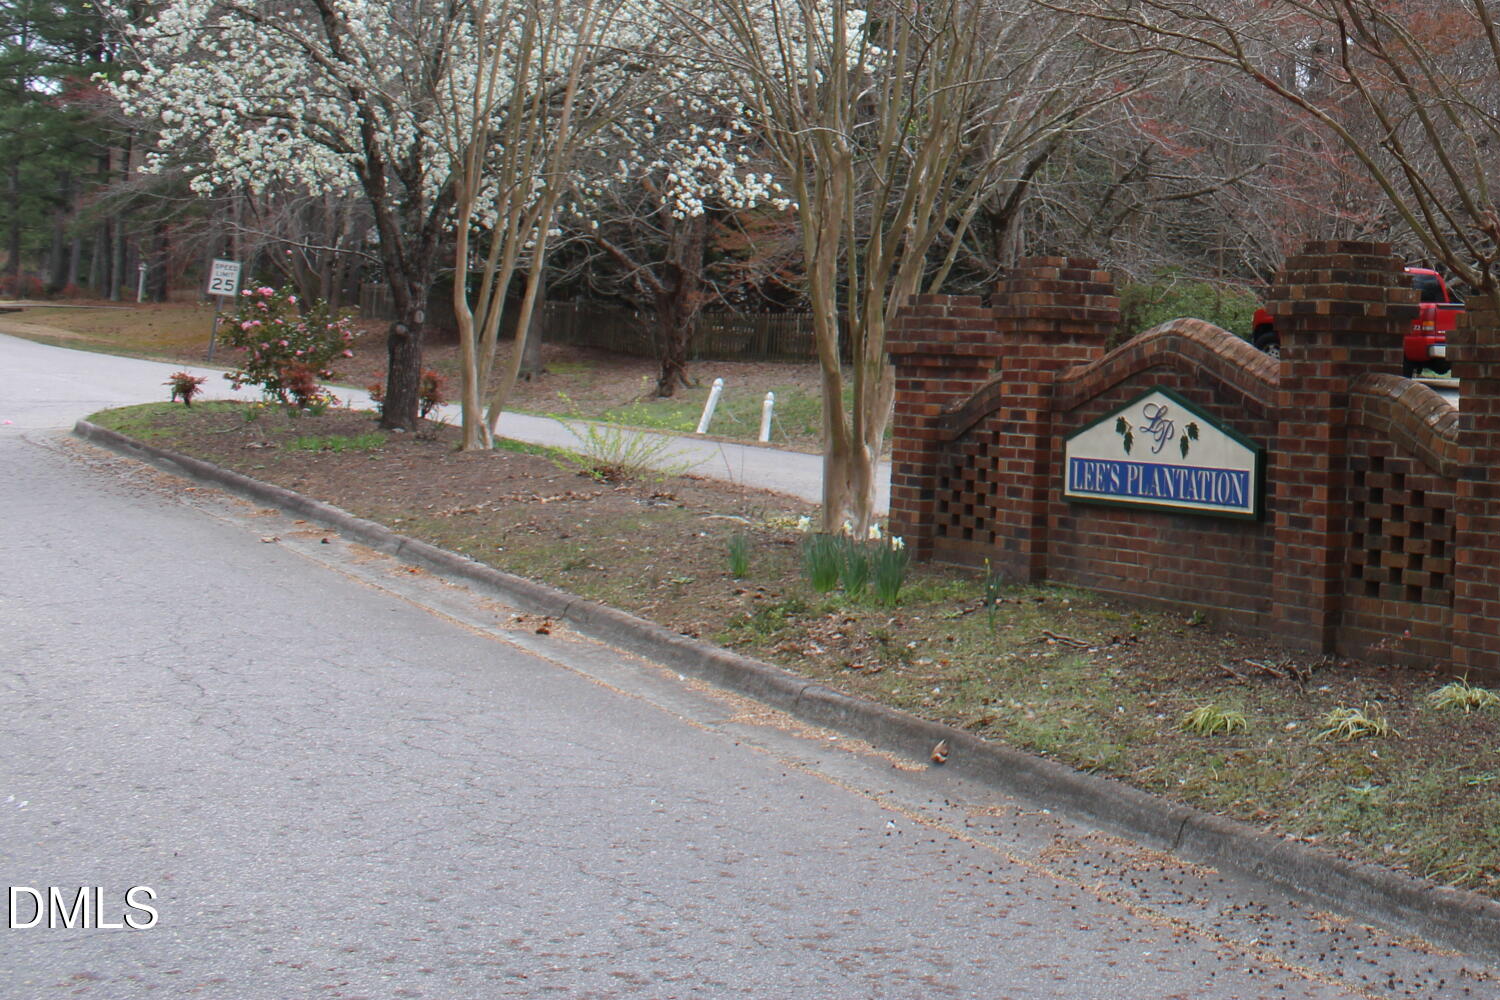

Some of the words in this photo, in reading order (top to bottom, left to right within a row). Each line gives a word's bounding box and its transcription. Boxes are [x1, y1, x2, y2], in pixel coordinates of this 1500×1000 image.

[215, 263, 239, 272] SPEED
[215, 270, 235, 278] LIMIT
[211, 277, 235, 292] 25
[1072, 460, 1121, 493] LEE'S
[1127, 464, 1244, 505] PLANTATION
